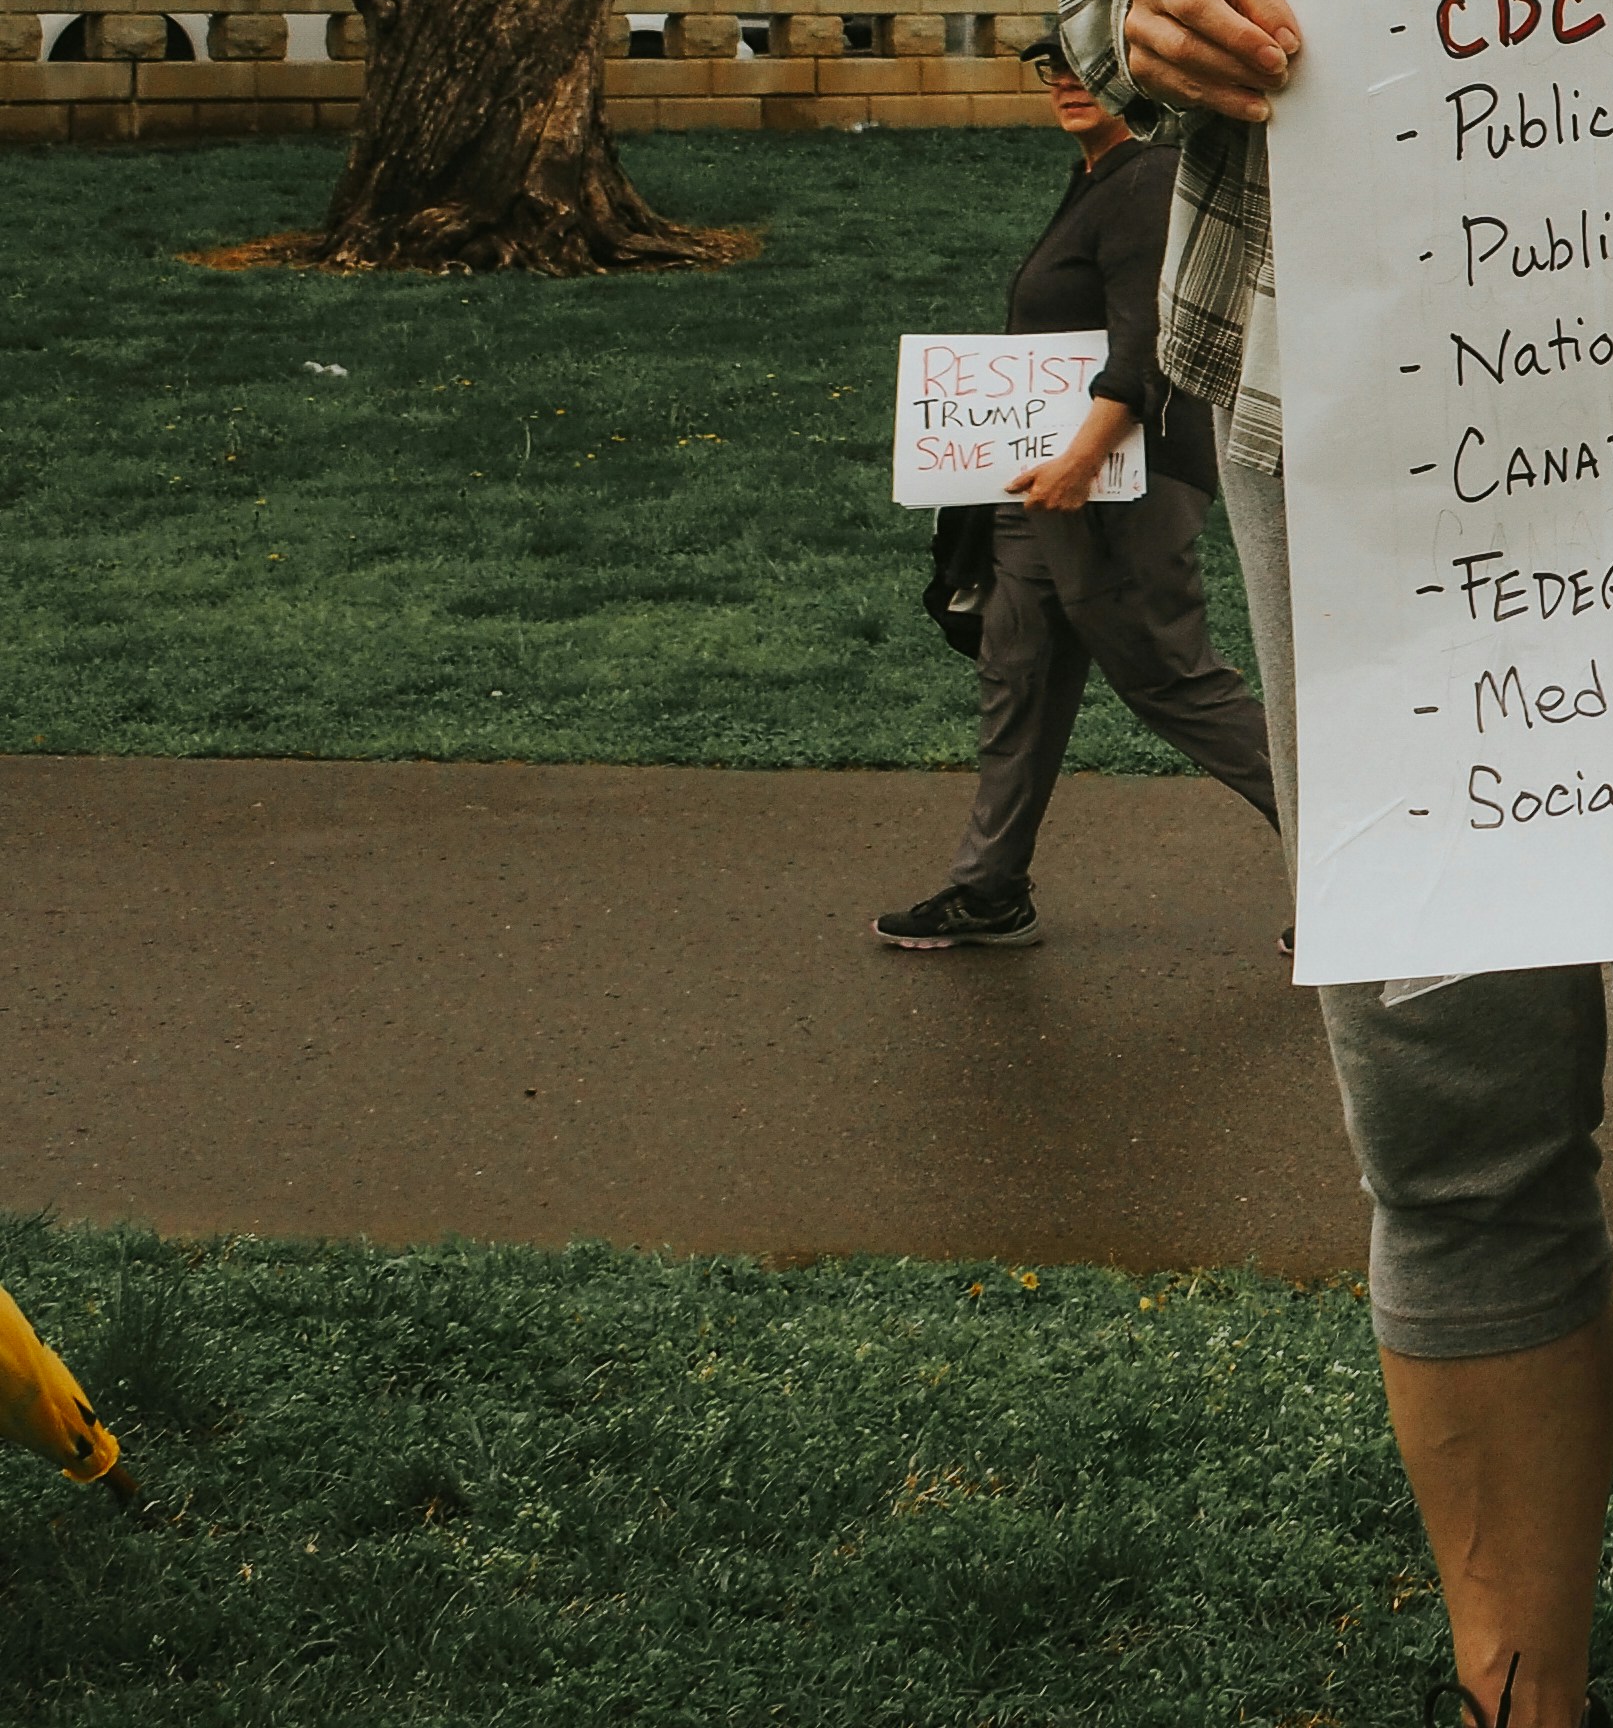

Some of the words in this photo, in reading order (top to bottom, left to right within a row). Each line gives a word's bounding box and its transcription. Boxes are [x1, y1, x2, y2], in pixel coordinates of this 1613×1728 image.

[914, 398, 1046, 430] TRUMP
[916, 436, 996, 472] SAVE
[1008, 432, 1058, 461] THE
